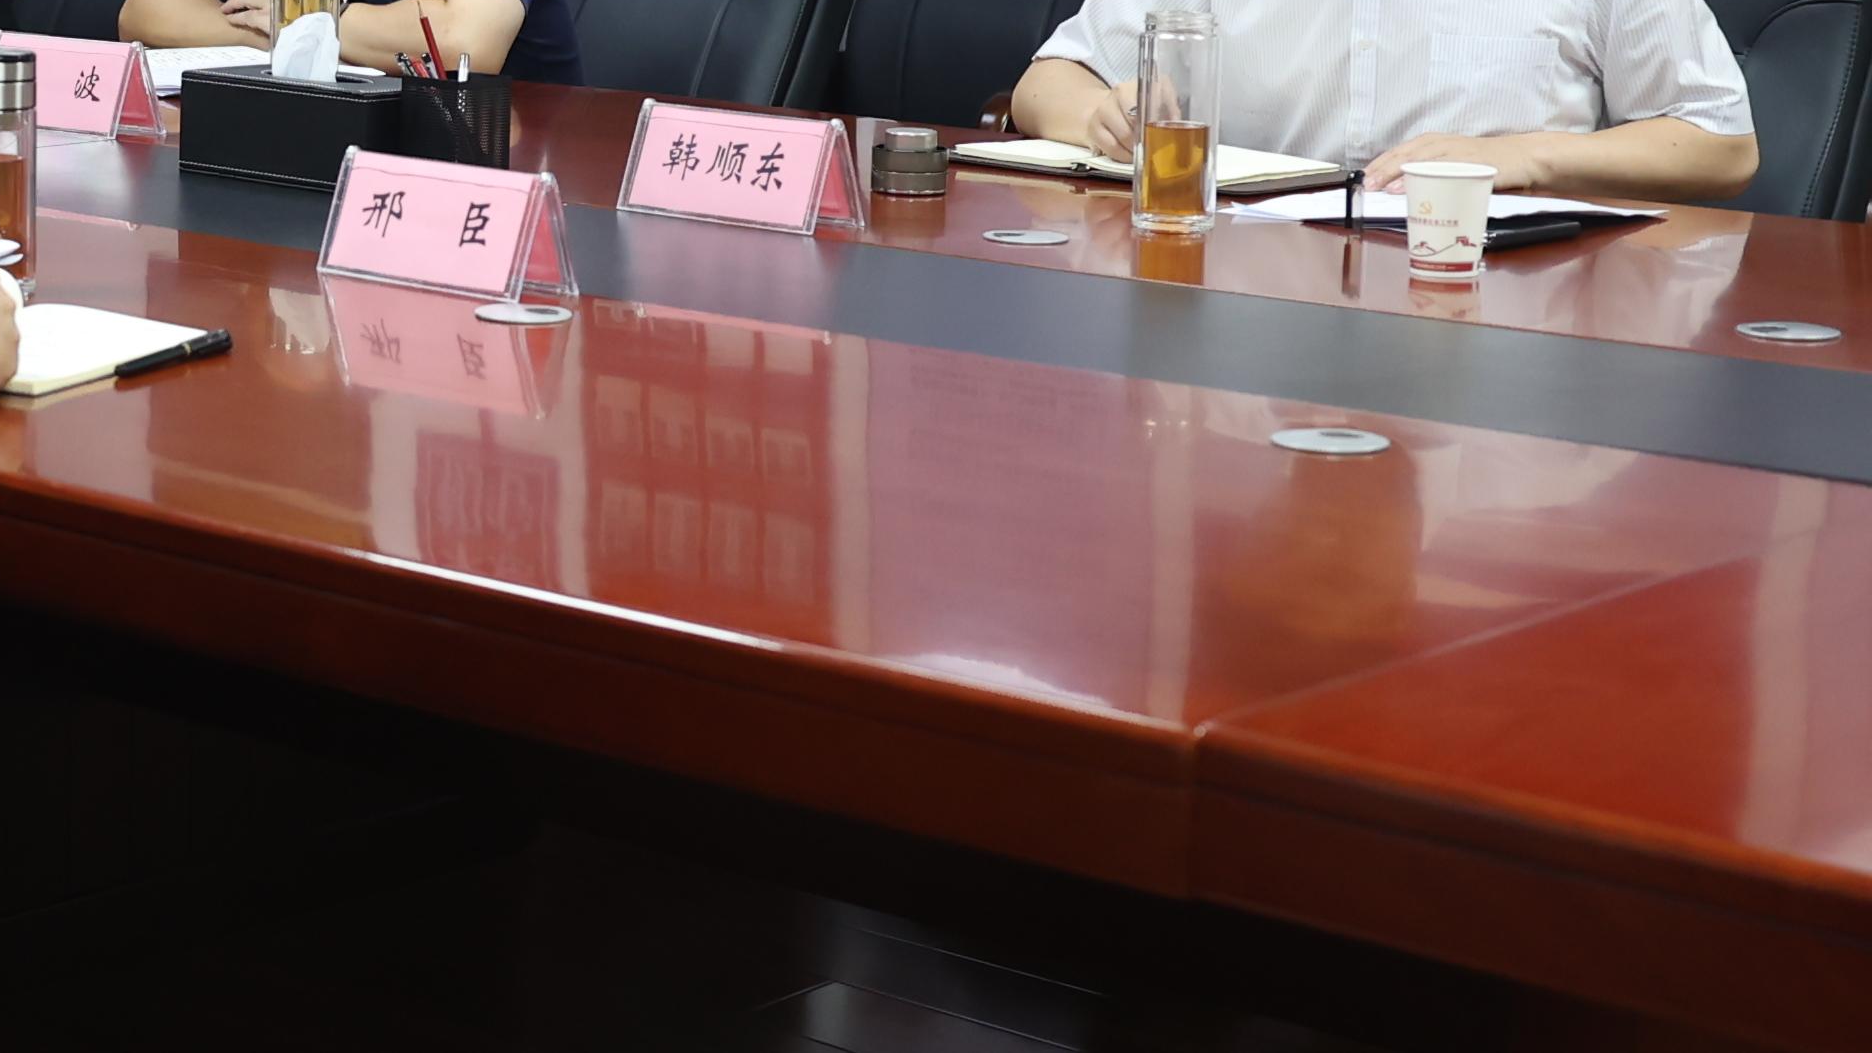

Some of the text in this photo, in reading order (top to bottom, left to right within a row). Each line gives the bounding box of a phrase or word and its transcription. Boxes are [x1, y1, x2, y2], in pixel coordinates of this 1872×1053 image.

[73, 65, 101, 102] 波
[662, 133, 785, 192] 韩顺东
[362, 191, 491, 248] 邢 臣
